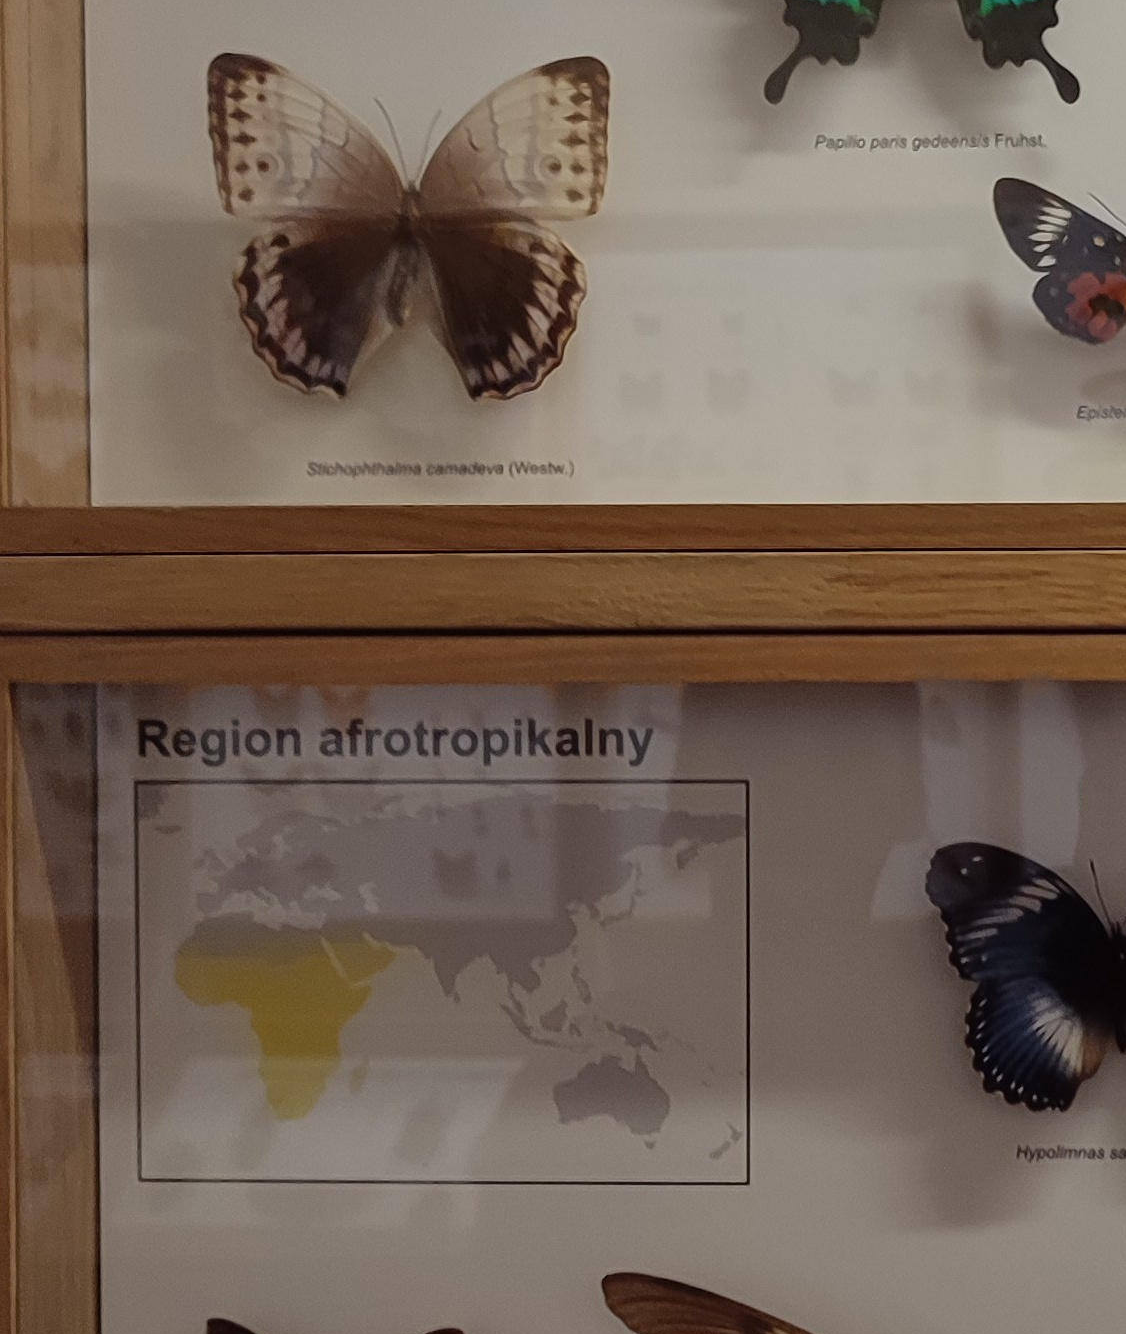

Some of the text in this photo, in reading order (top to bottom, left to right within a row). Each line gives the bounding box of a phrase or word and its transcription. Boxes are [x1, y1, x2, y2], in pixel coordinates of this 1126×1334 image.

[815, 135, 865, 151] Papilio
[870, 136, 907, 150] paris
[912, 135, 989, 151] gedeensis
[509, 461, 574, 478] (Westw.)
[137, 718, 653, 766] Region afrotropikalny
[1016, 1145, 1104, 1162] Hypolimnas
